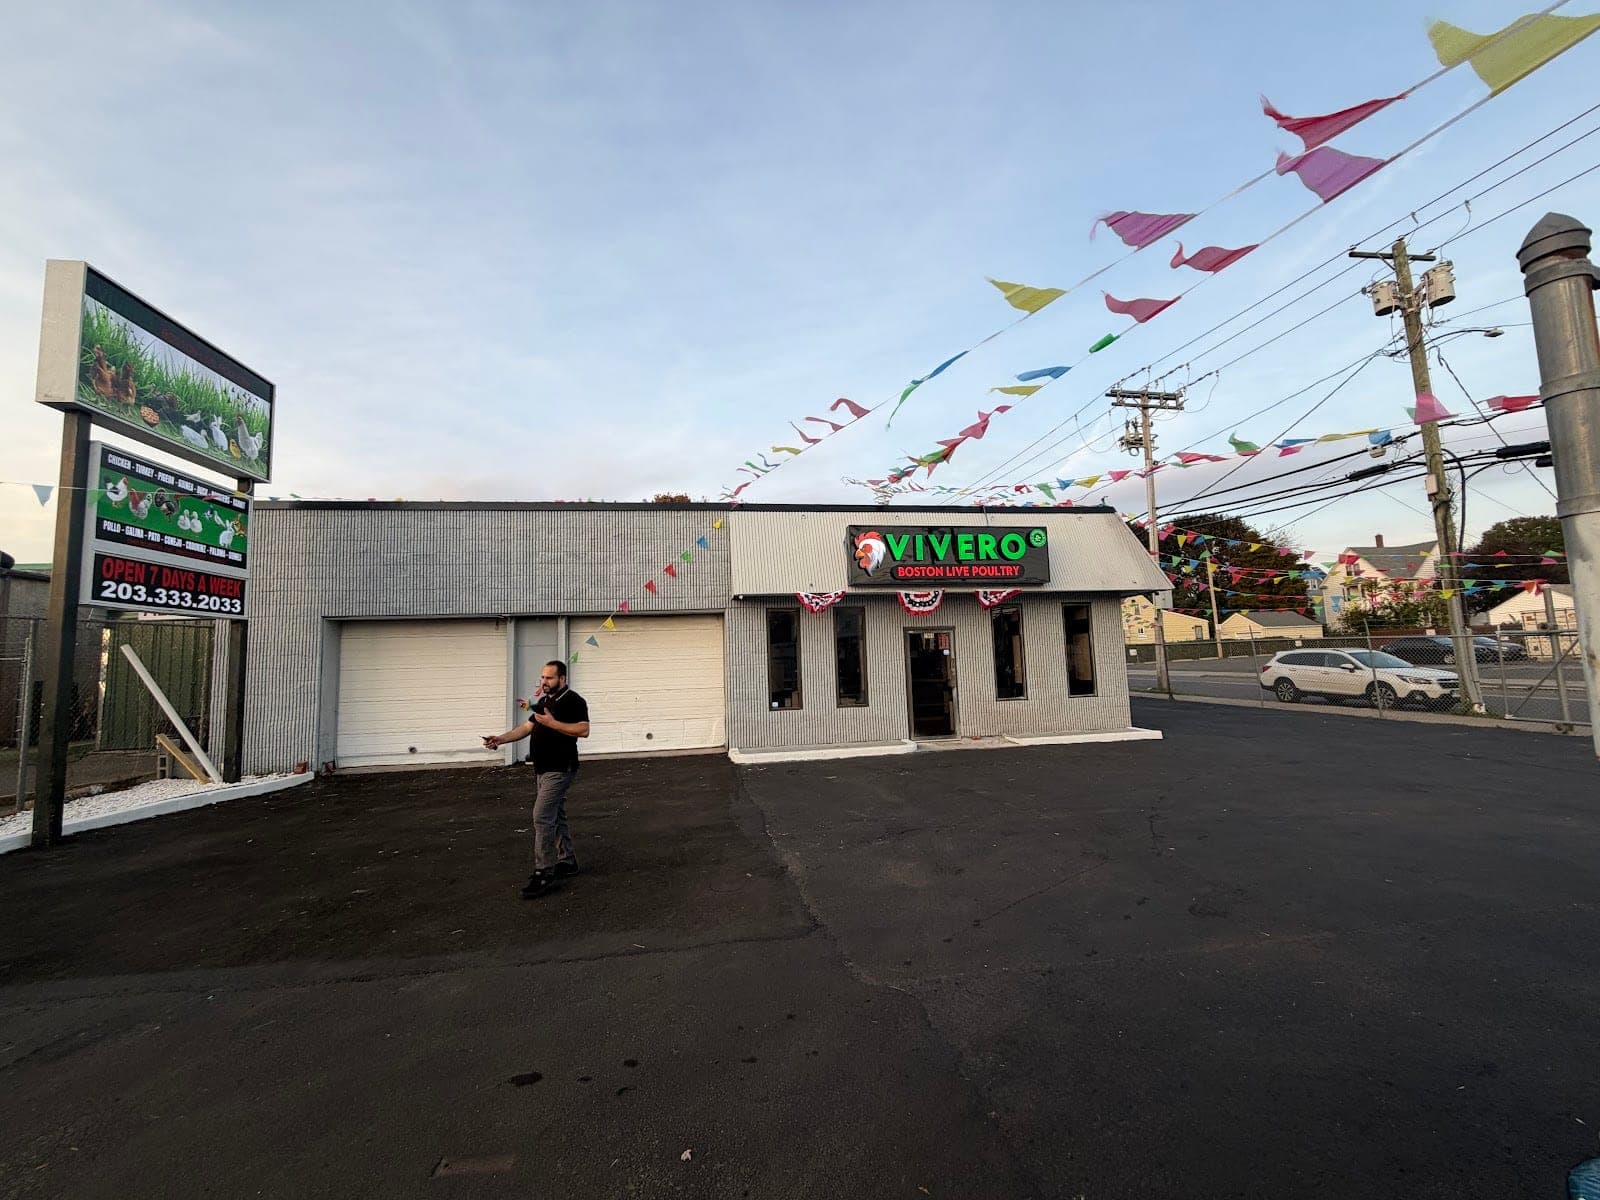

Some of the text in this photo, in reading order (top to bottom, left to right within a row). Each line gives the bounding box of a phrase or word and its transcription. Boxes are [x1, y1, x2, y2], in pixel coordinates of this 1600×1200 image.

[103, 520, 121, 534] POLLO
[885, 533, 1027, 561] VIVERO
[102, 557, 242, 598] OPEN 7 DAYS A WEEK
[898, 565, 1020, 577] BOSTON LIVE POULTRY
[100, 581, 242, 613] 203.333.2033
